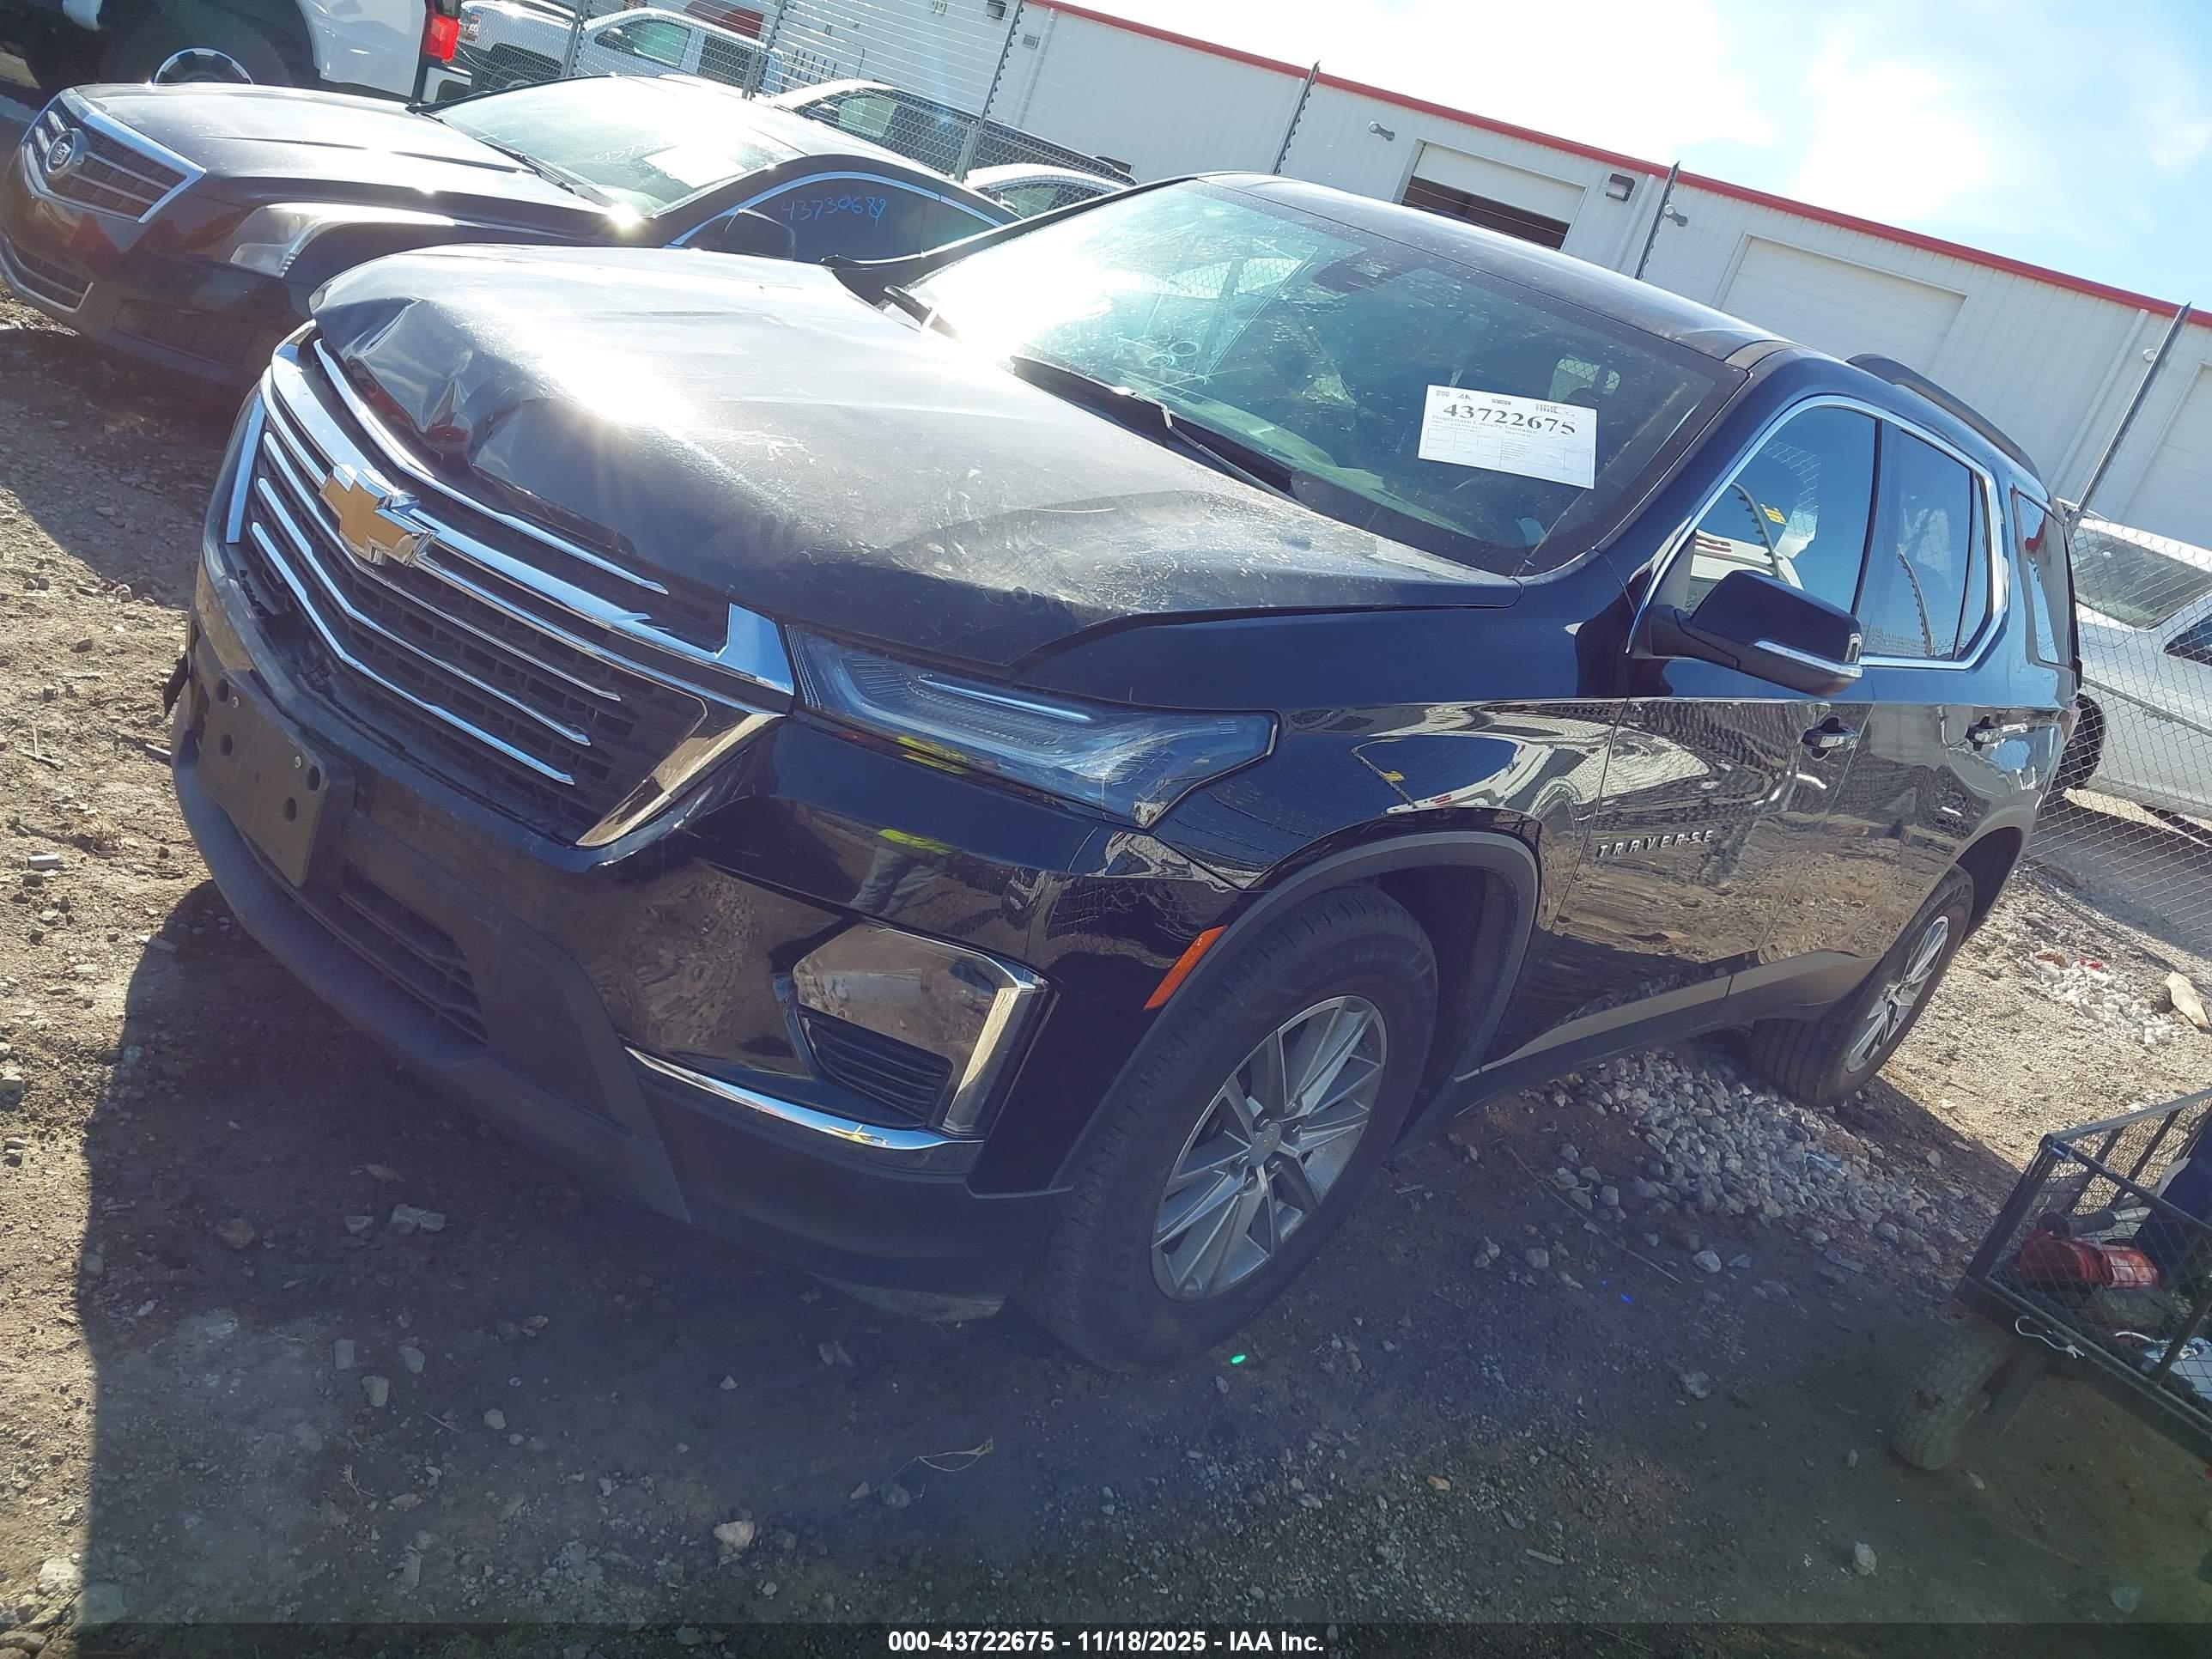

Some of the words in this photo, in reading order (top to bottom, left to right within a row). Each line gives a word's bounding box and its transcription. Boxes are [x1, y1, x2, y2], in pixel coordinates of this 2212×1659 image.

[781, 196, 886, 227] 43730689
[1443, 404, 1577, 434] 43722675
[1597, 830, 1714, 858] TRAVERSE
